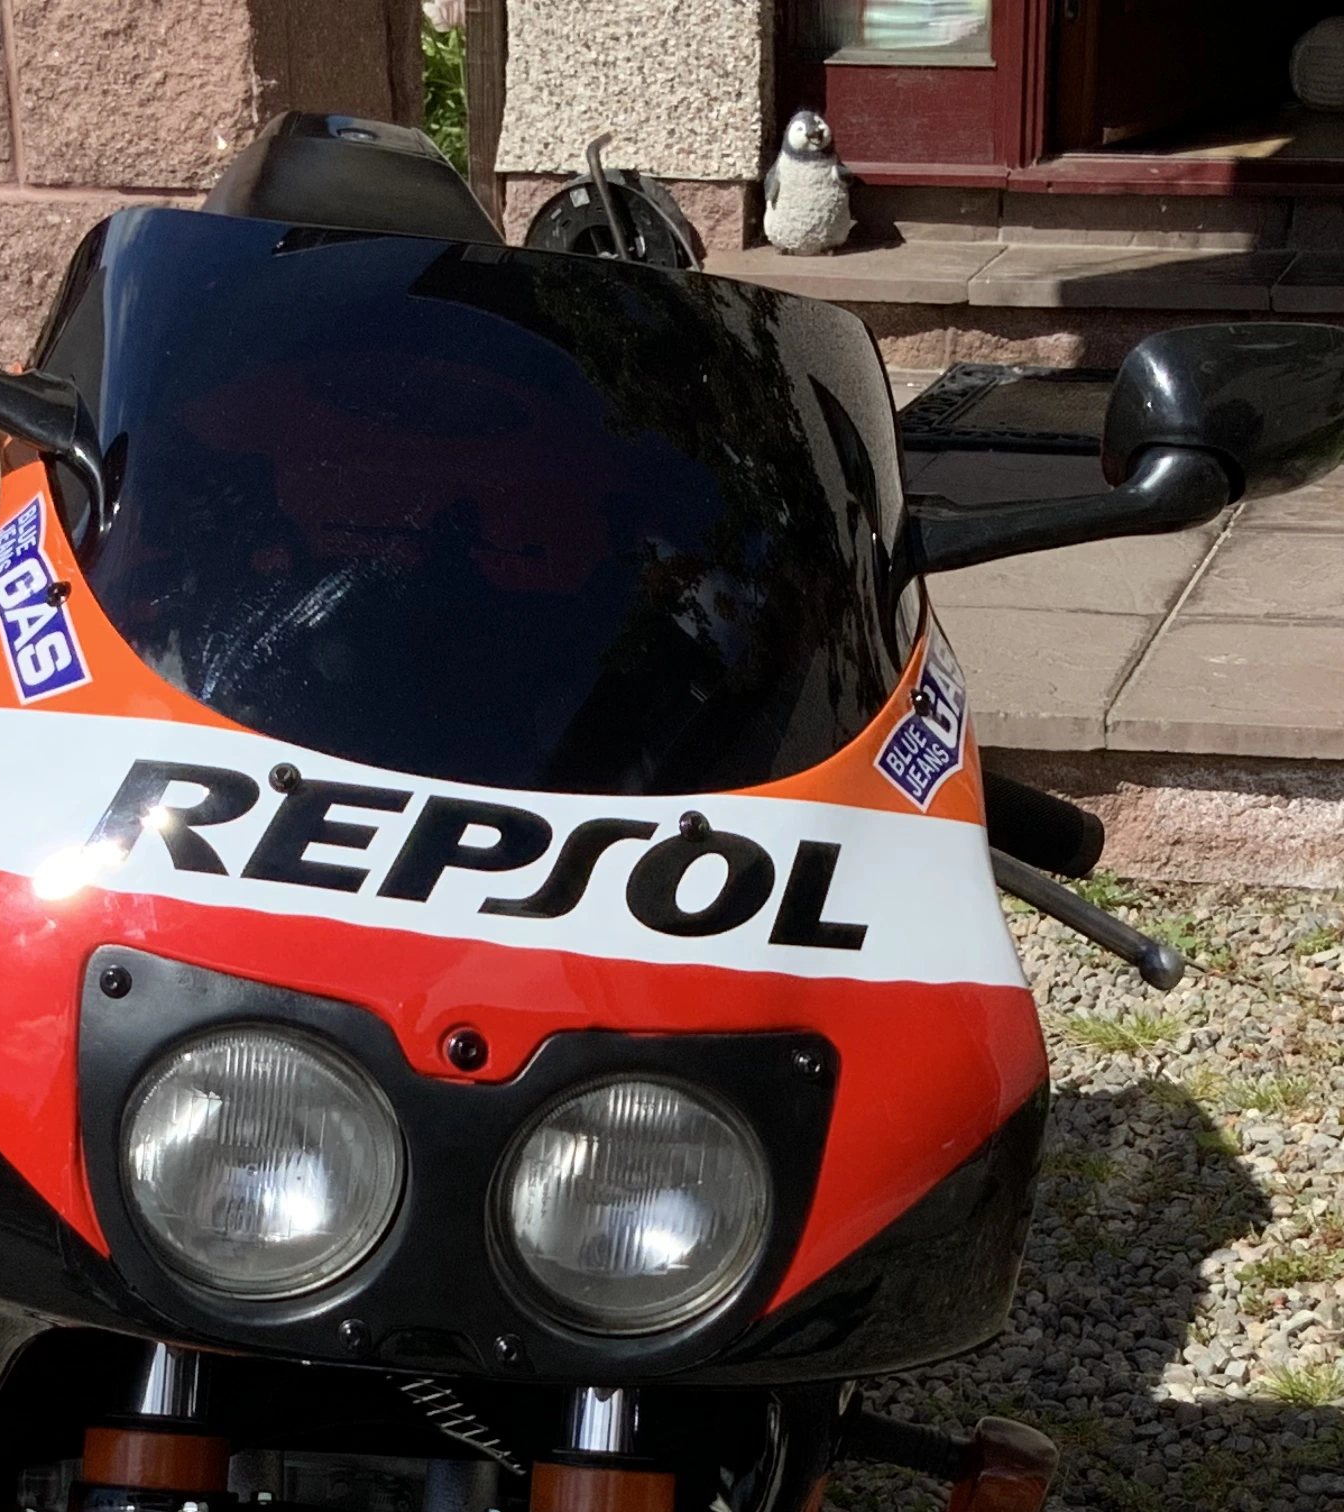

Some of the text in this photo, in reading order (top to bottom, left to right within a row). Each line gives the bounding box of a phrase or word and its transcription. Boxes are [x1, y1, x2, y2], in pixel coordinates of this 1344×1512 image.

[16, 505, 37, 556] BLUE
[886, 724, 927, 776] BLUE
[906, 743, 950, 797] JEANS
[80, 759, 867, 950] REPSOL
